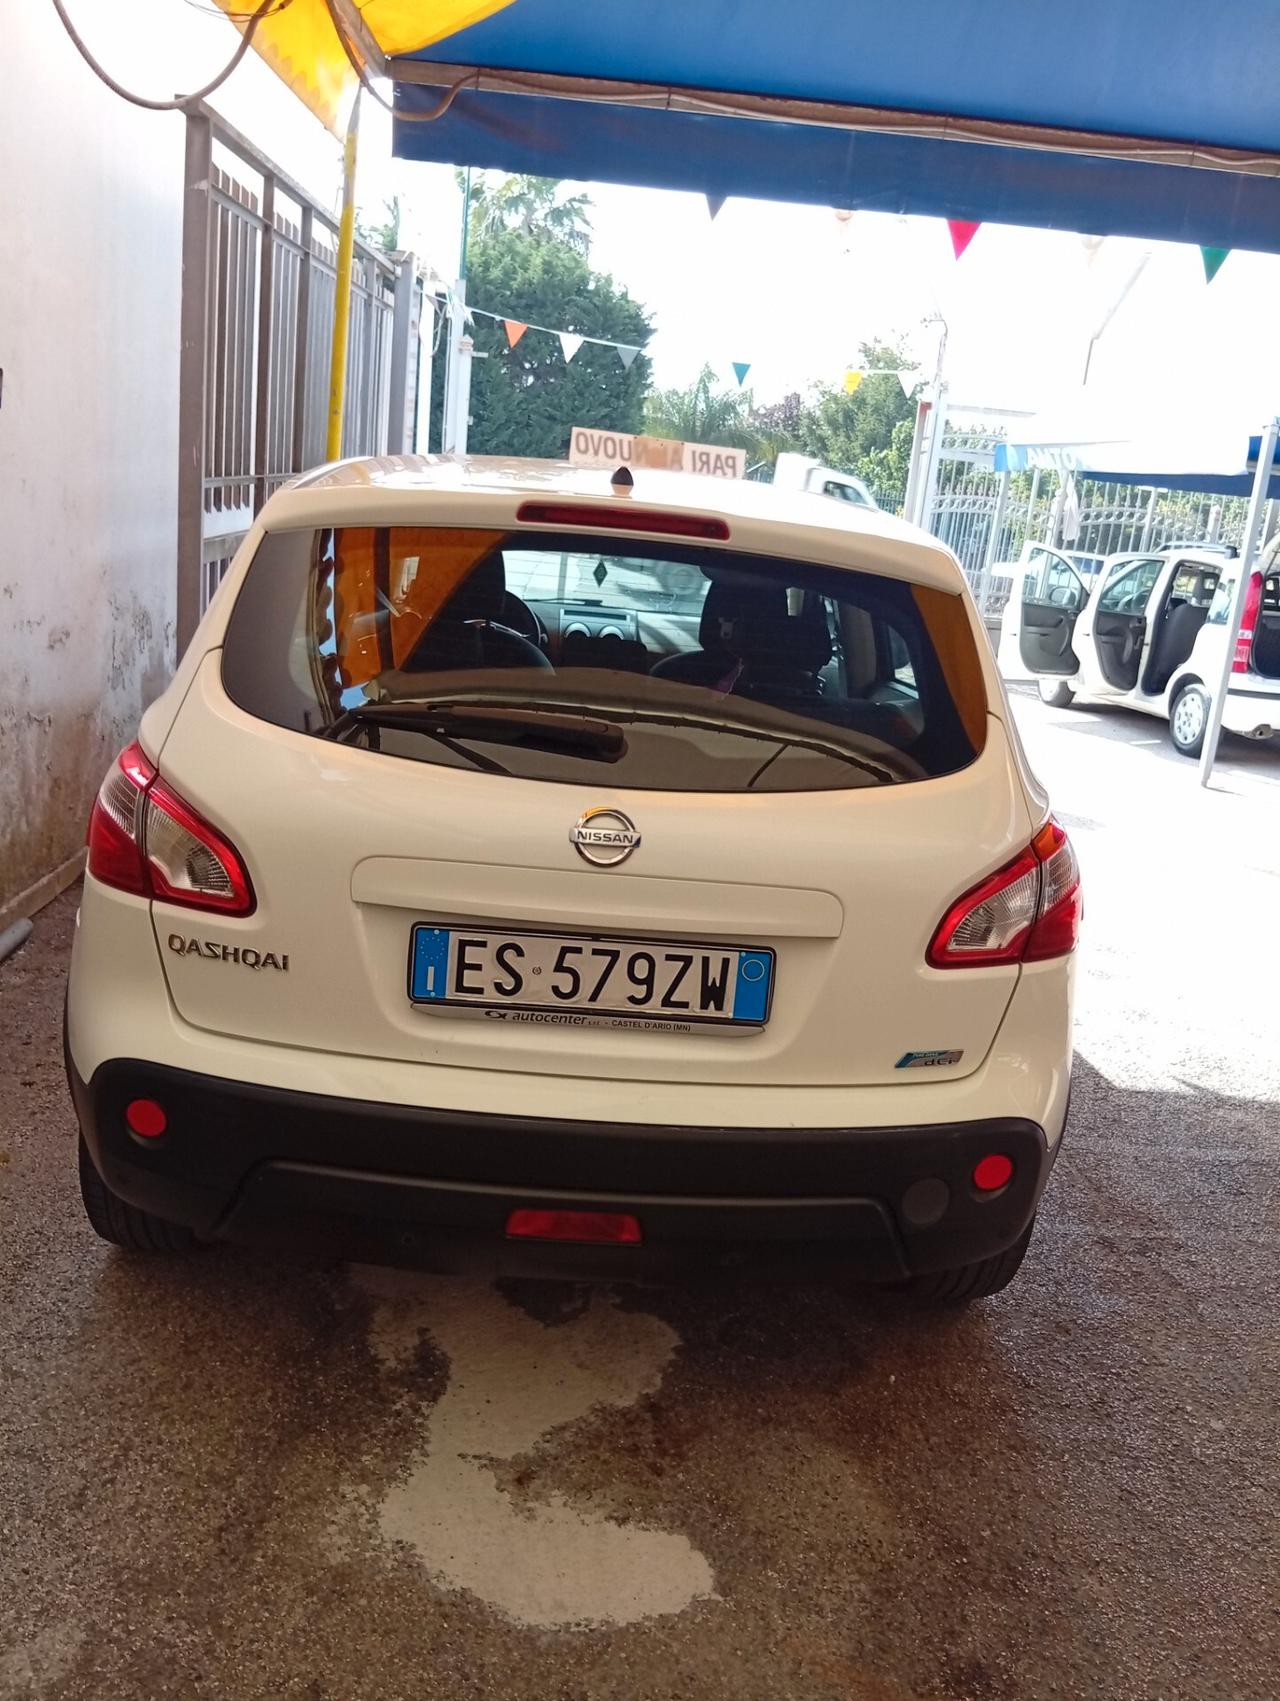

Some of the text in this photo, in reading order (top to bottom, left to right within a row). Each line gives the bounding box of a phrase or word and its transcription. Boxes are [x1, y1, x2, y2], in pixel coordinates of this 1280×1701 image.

[577, 830, 633, 844] NISSAN
[168, 933, 289, 971] QASHQAI
[426, 966, 435, 991] I
[454, 937, 730, 1011] ES 579ZW
[512, 1012, 587, 1025] autocenter
[611, 1020, 642, 1028] CASTEL
[645, 1022, 672, 1030] D'ARIO
[673, 1024, 691, 1032] (MN)
